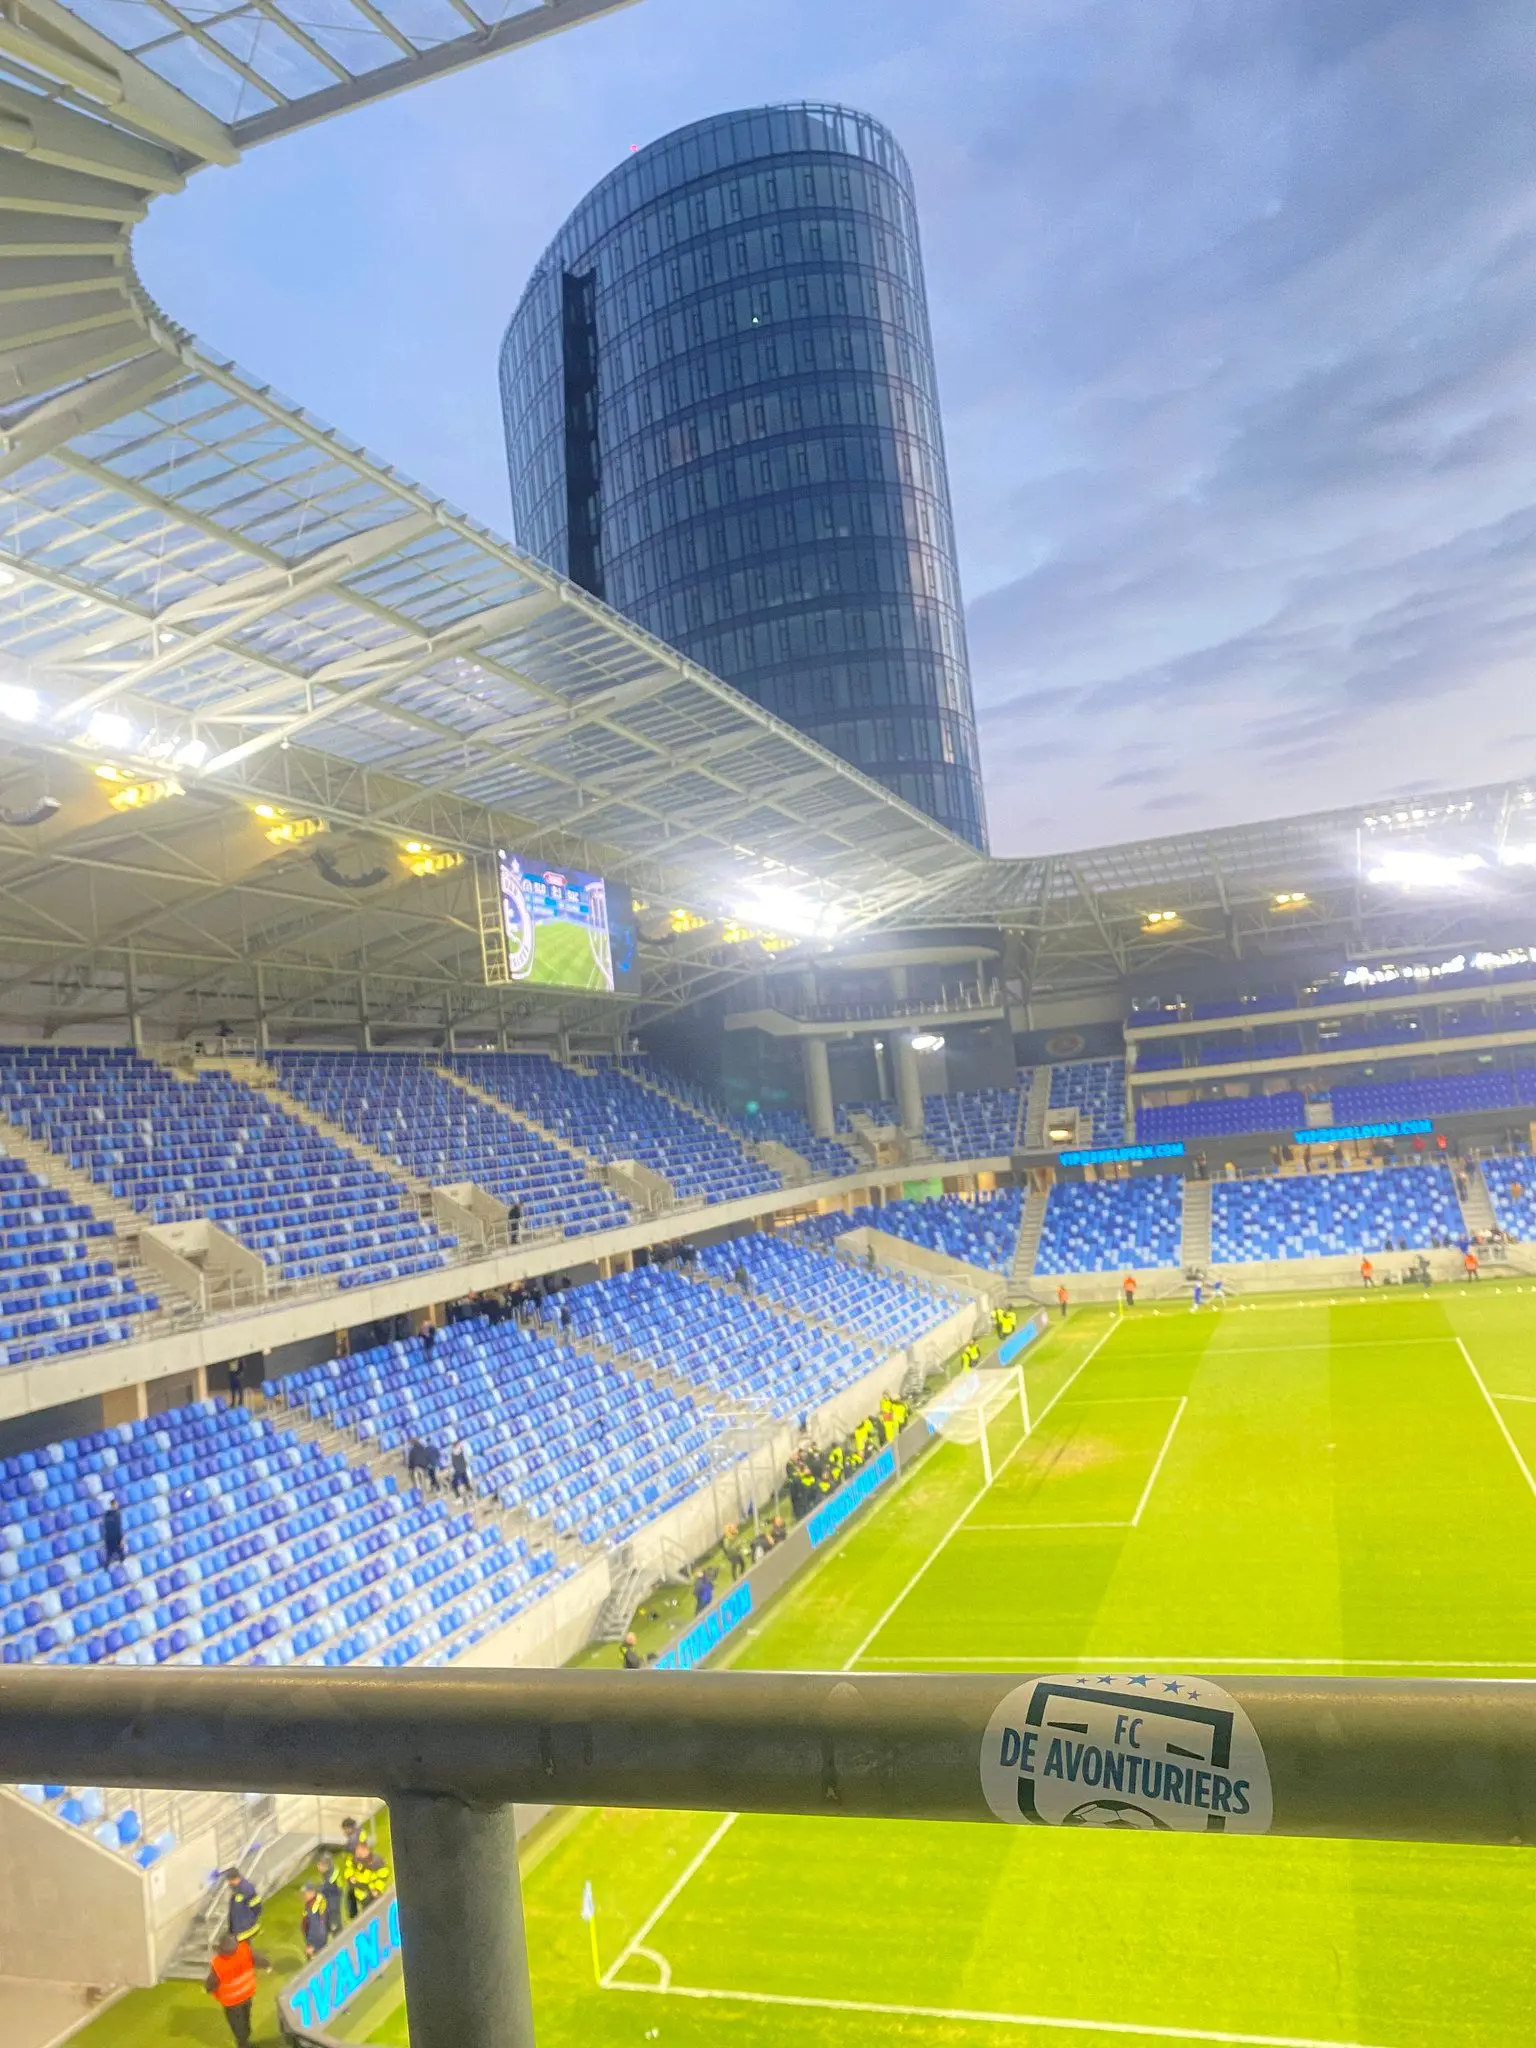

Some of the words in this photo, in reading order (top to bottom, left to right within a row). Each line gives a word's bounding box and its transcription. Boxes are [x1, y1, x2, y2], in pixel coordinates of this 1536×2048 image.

[1114, 1714, 1144, 1749] FC
[1000, 1727, 1038, 1773] DE
[1043, 1737, 1250, 1815] AVONTURIERS
